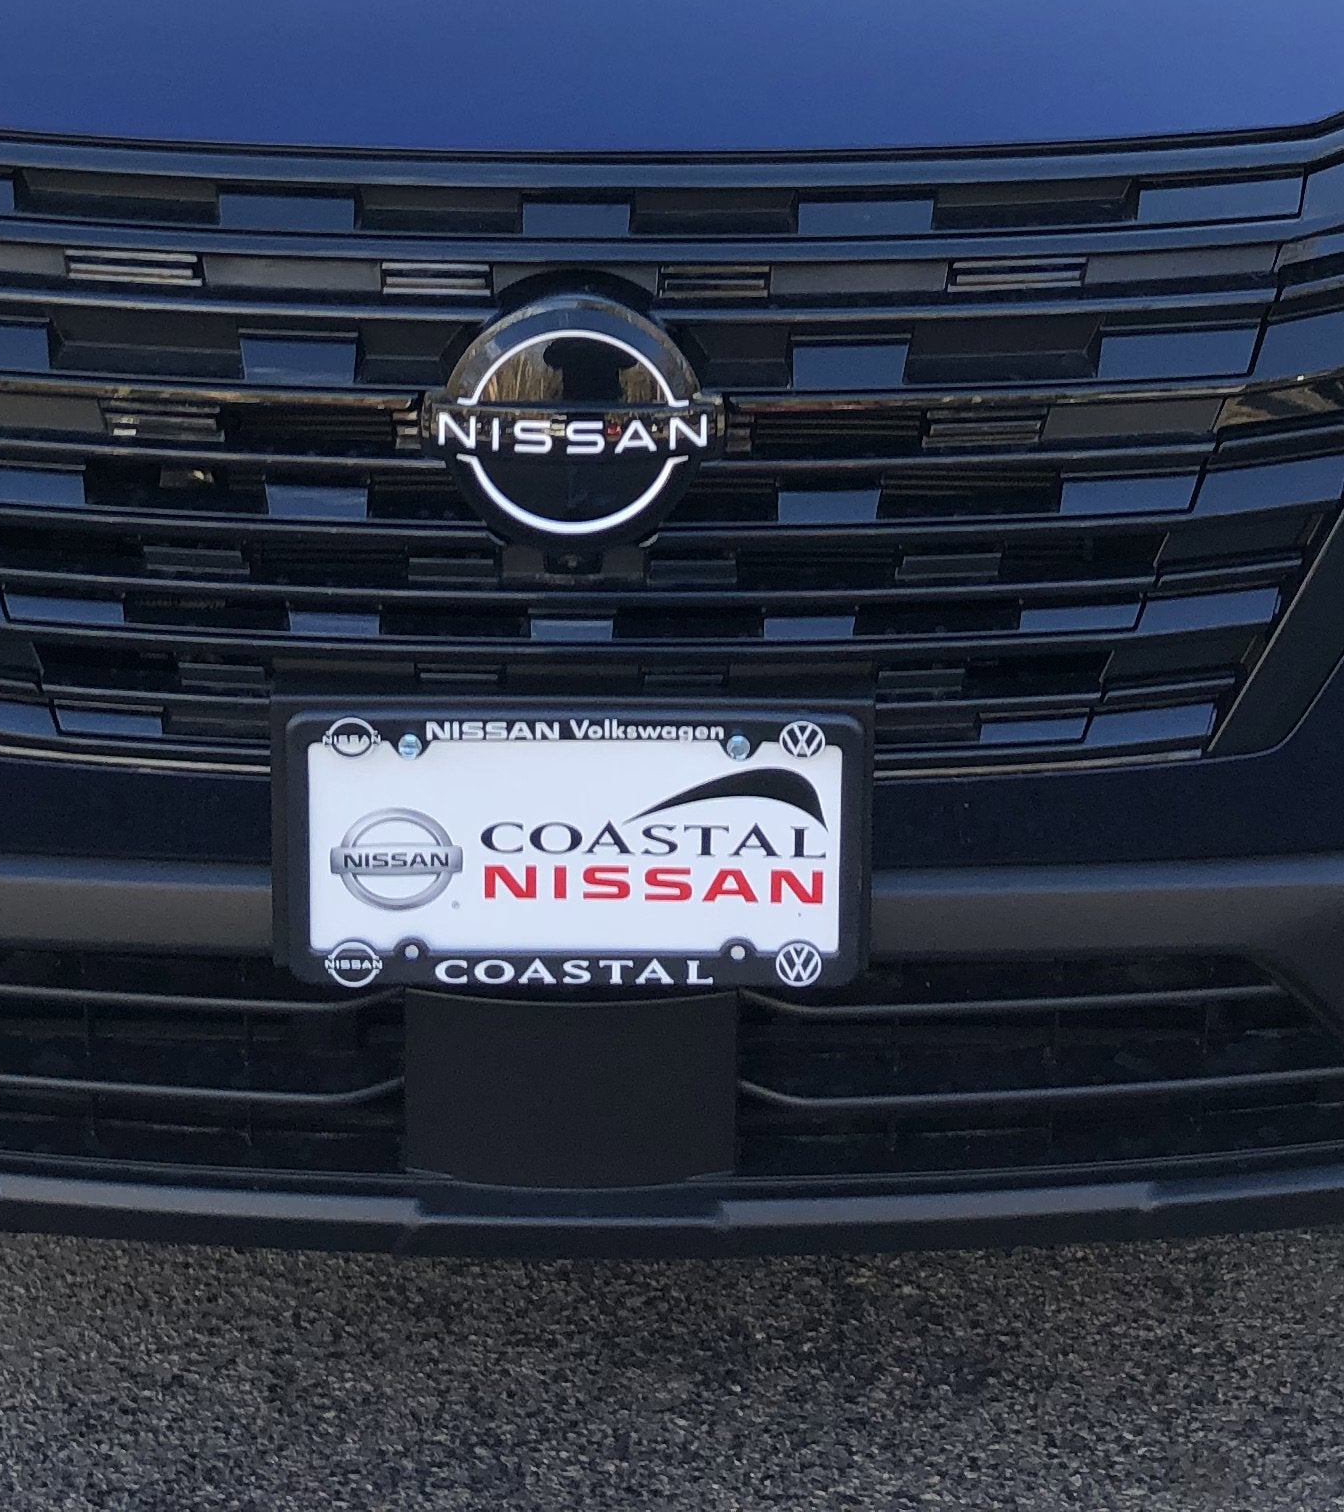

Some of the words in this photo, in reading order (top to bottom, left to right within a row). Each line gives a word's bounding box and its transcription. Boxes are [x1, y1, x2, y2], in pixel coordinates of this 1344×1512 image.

[438, 413, 707, 454] NISSAN
[425, 720, 560, 740] NISSAN
[569, 719, 725, 743] Volkswagen
[480, 820, 827, 859] COASTAL
[343, 852, 450, 869] NISSAN
[483, 864, 824, 904] NISSAN
[324, 959, 383, 969] NISSAN
[435, 958, 714, 985] COASTAL
